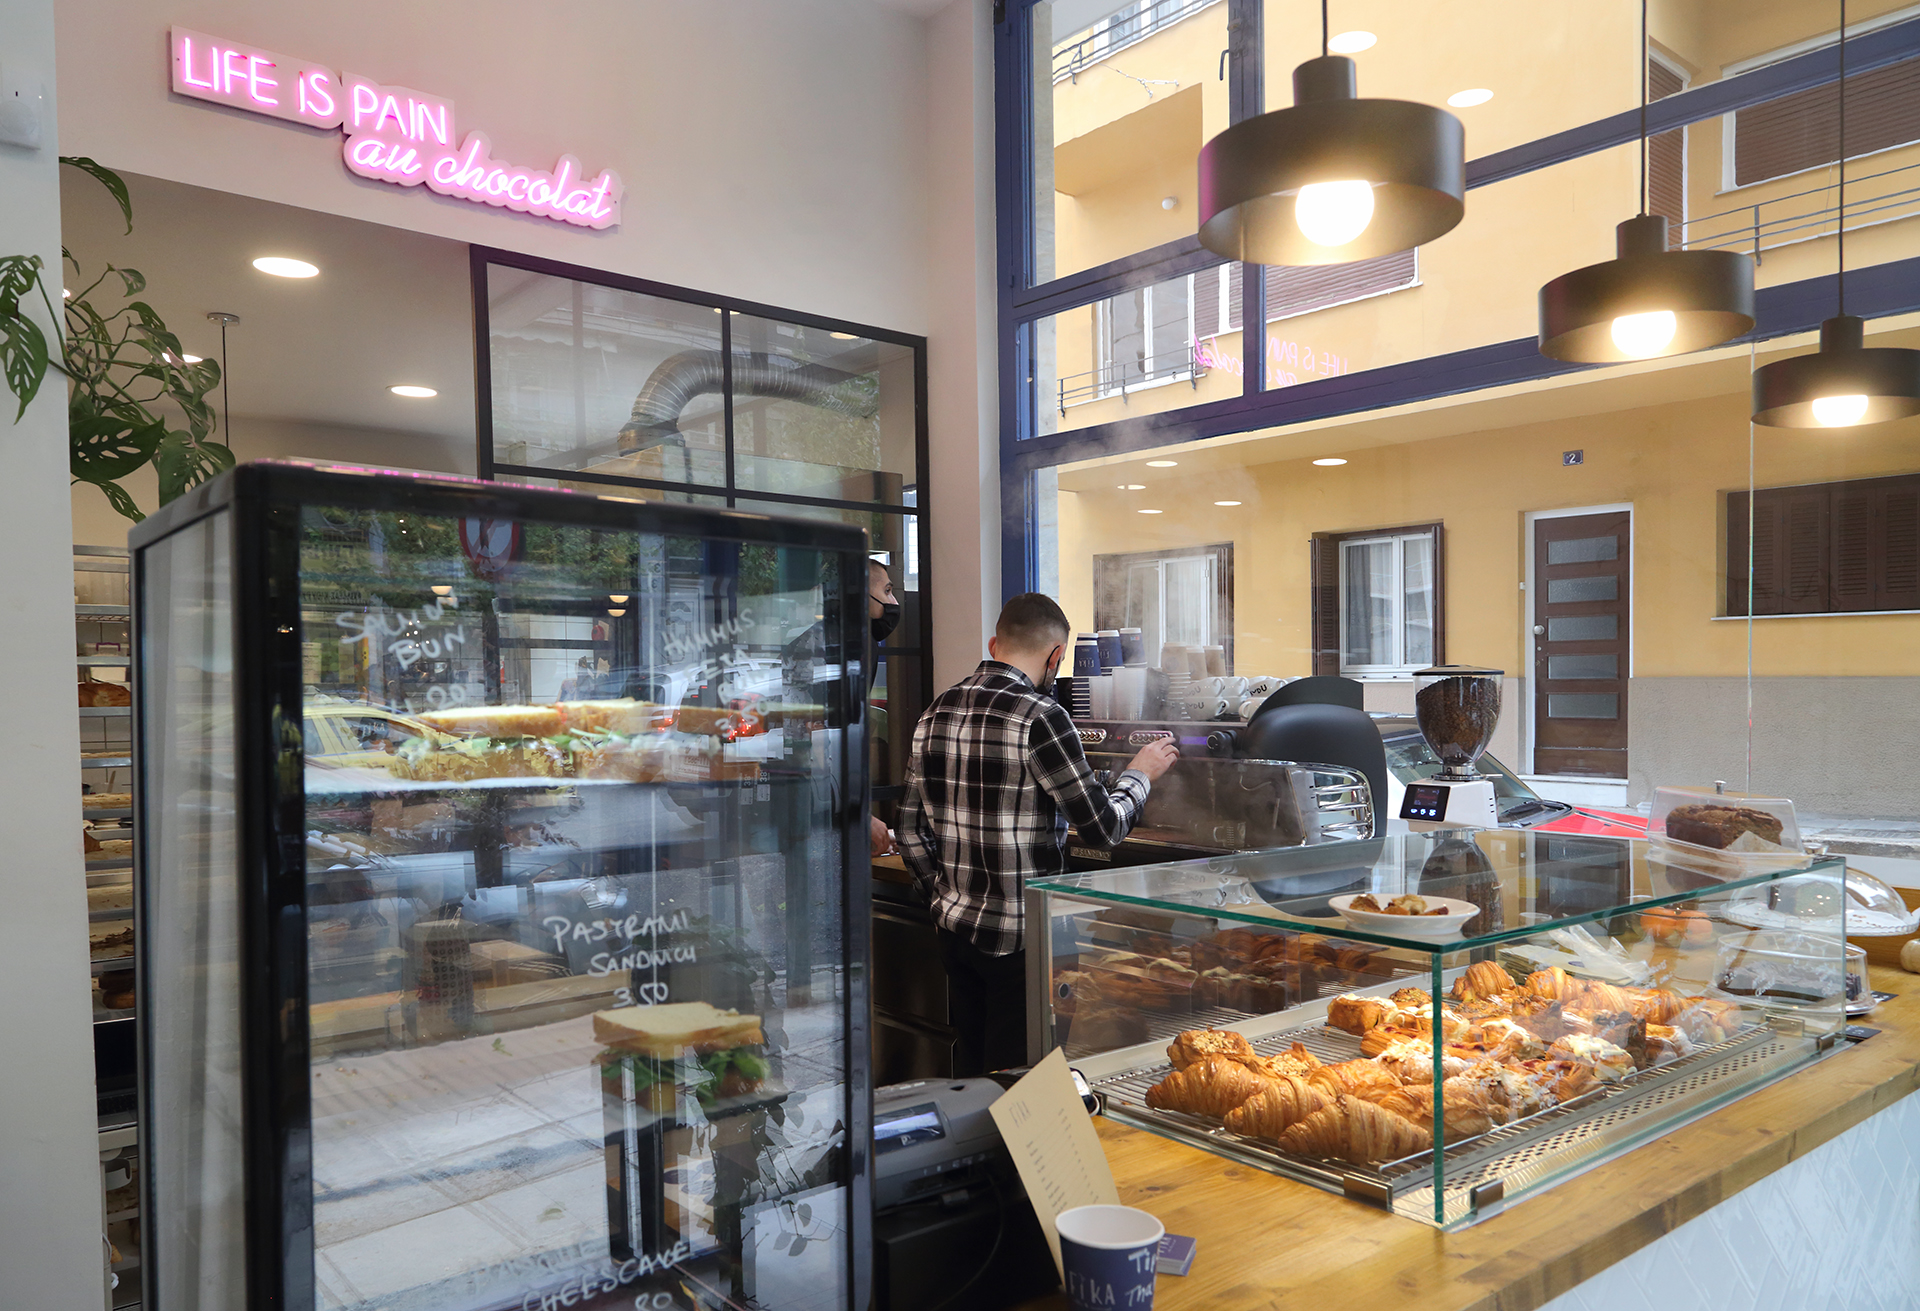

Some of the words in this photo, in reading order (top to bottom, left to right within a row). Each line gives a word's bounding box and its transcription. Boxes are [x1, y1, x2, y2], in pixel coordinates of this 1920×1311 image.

[183, 36, 279, 106] LIFE
[298, 70, 336, 118] IS
[352, 83, 448, 146] PAIN
[352, 138, 422, 175] au
[433, 138, 612, 219] chocolat
[1569, 453, 1576, 464] 2
[388, 624, 466, 671] BUN
[542, 910, 691, 954] PASTRAMI
[587, 945, 698, 978] SANDWICH
[1068, 1270, 1116, 1306] FIKA
